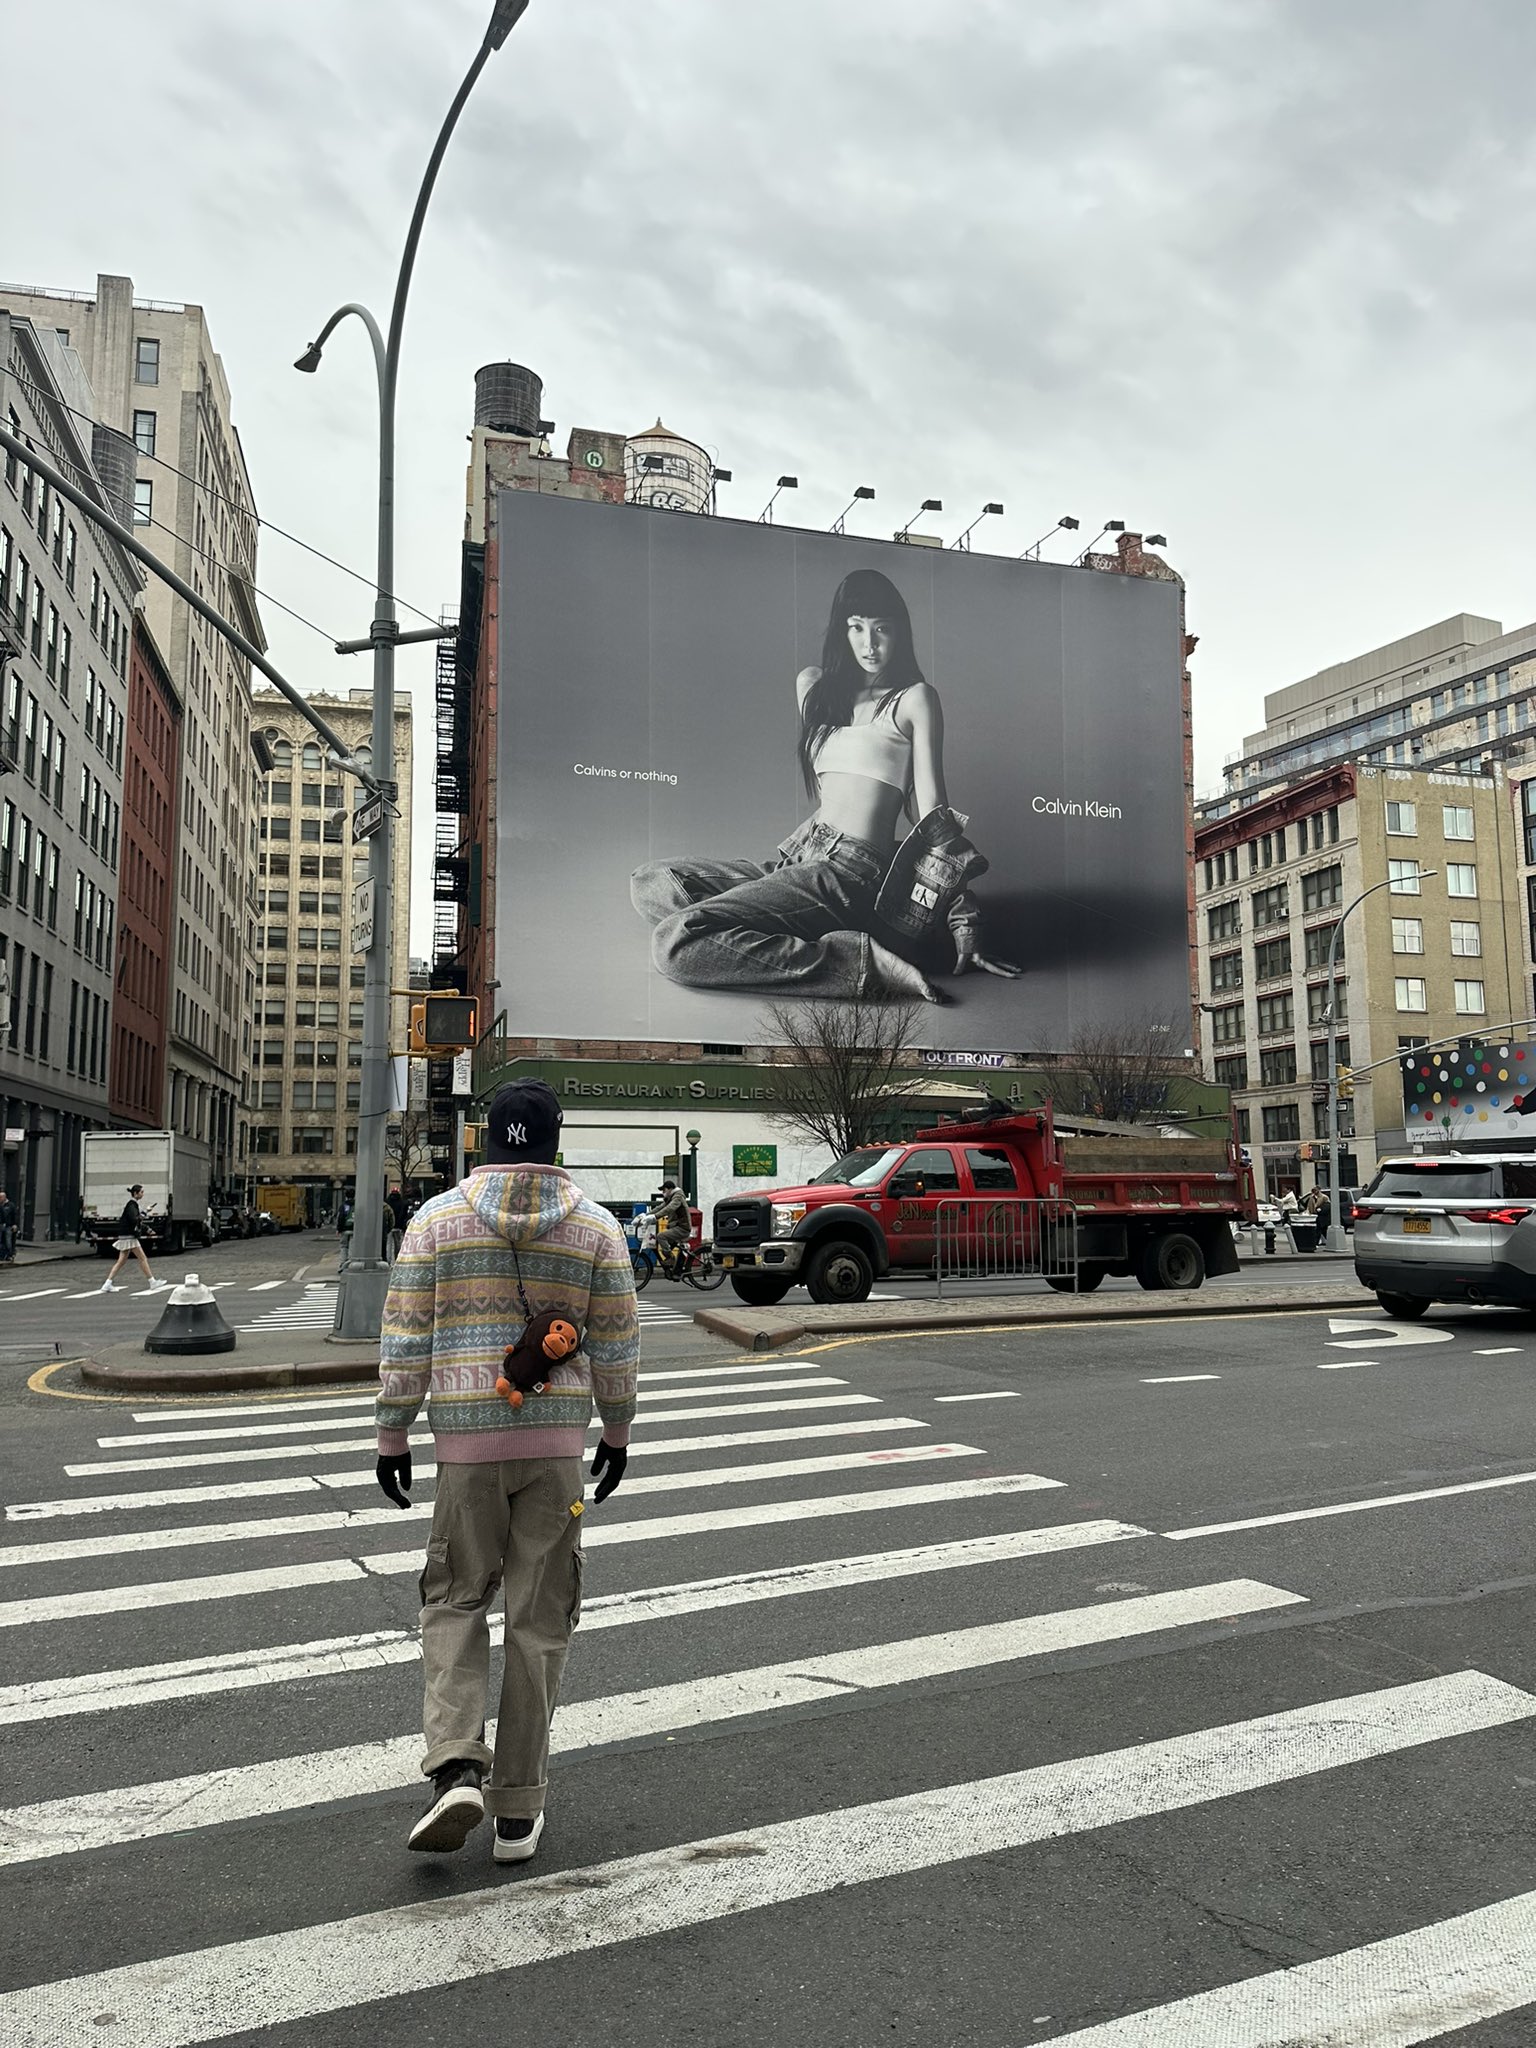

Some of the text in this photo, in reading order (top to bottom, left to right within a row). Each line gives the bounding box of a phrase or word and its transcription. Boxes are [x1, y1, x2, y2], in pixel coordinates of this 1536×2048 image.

[573, 763, 678, 786] Calvins or nothing
[355, 804, 381, 833] ONE WAY
[1031, 796, 1122, 819] Calvin Klein
[359, 892, 369, 914] NO
[354, 918, 372, 943] TURNS
[926, 1051, 1002, 1066] OUTFRONT
[563, 1077, 686, 1098] RESTAURANT
[507, 1123, 527, 1144] NY
[896, 1201, 920, 1220] J&N
